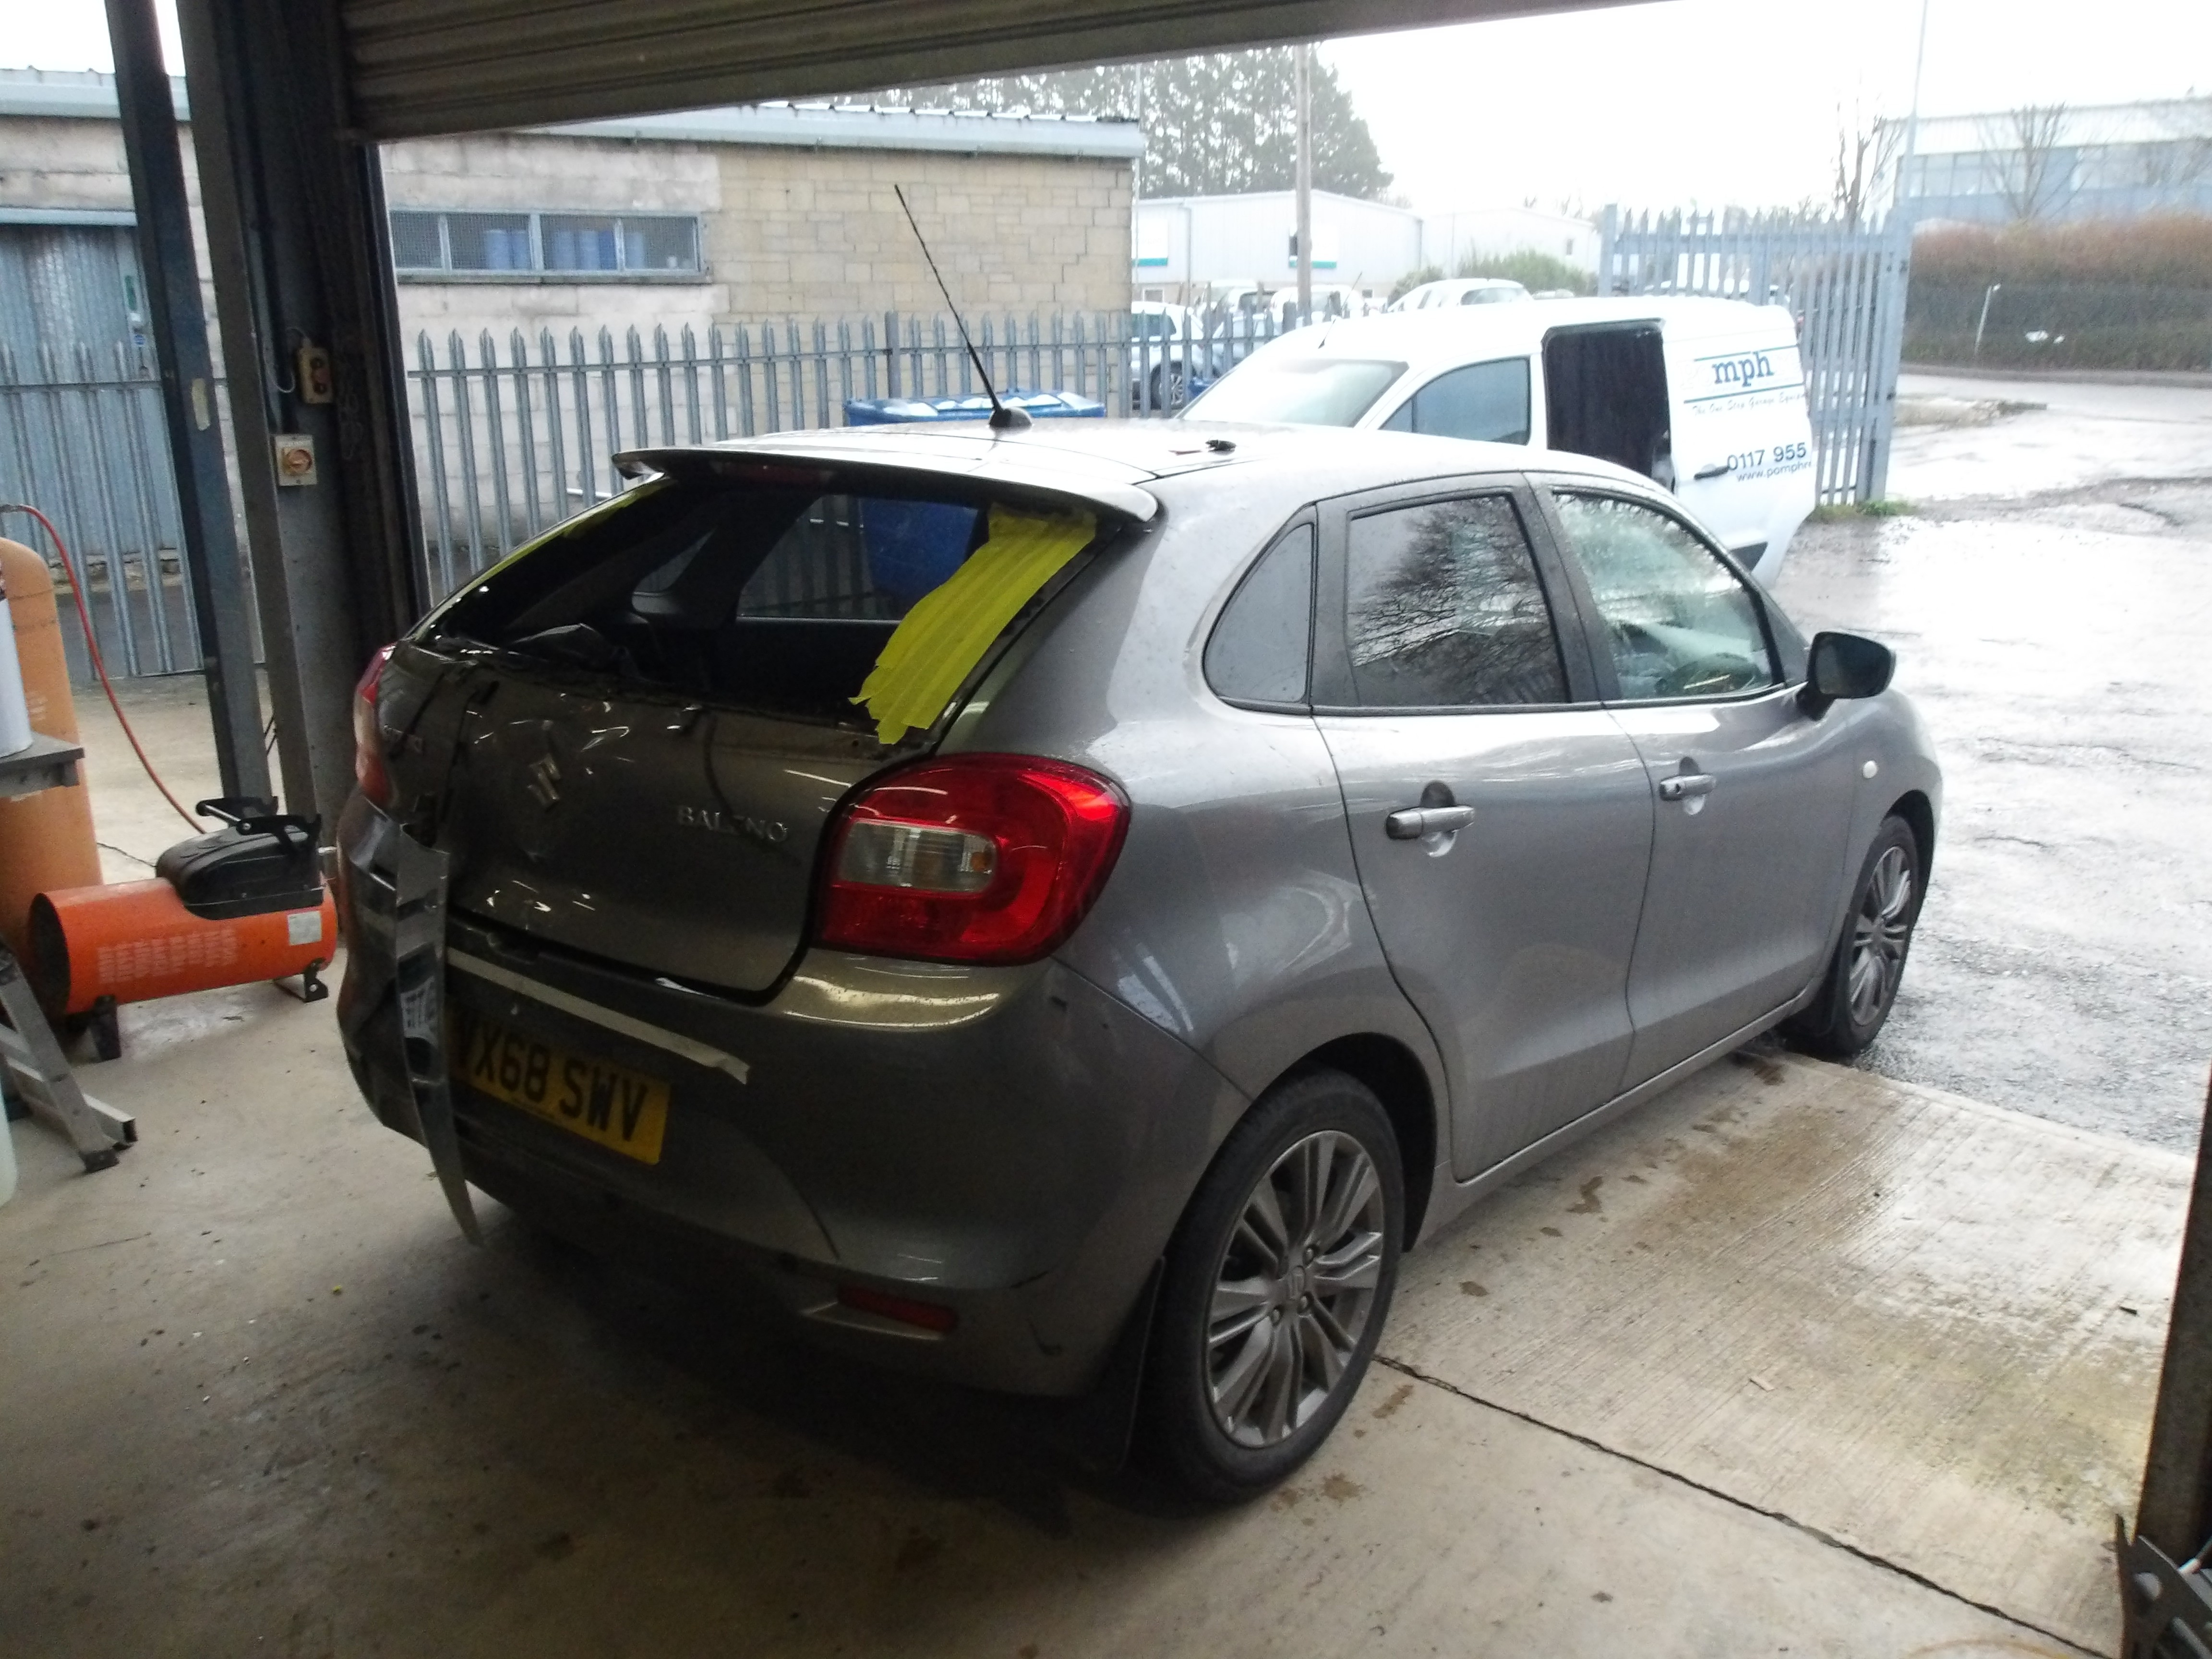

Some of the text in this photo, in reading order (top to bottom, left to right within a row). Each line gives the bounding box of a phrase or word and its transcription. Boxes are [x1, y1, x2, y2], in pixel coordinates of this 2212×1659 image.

[1712, 351, 1775, 387] mph
[1727, 442, 1806, 470] 0117 955
[559, 1058, 648, 1142] SWV
